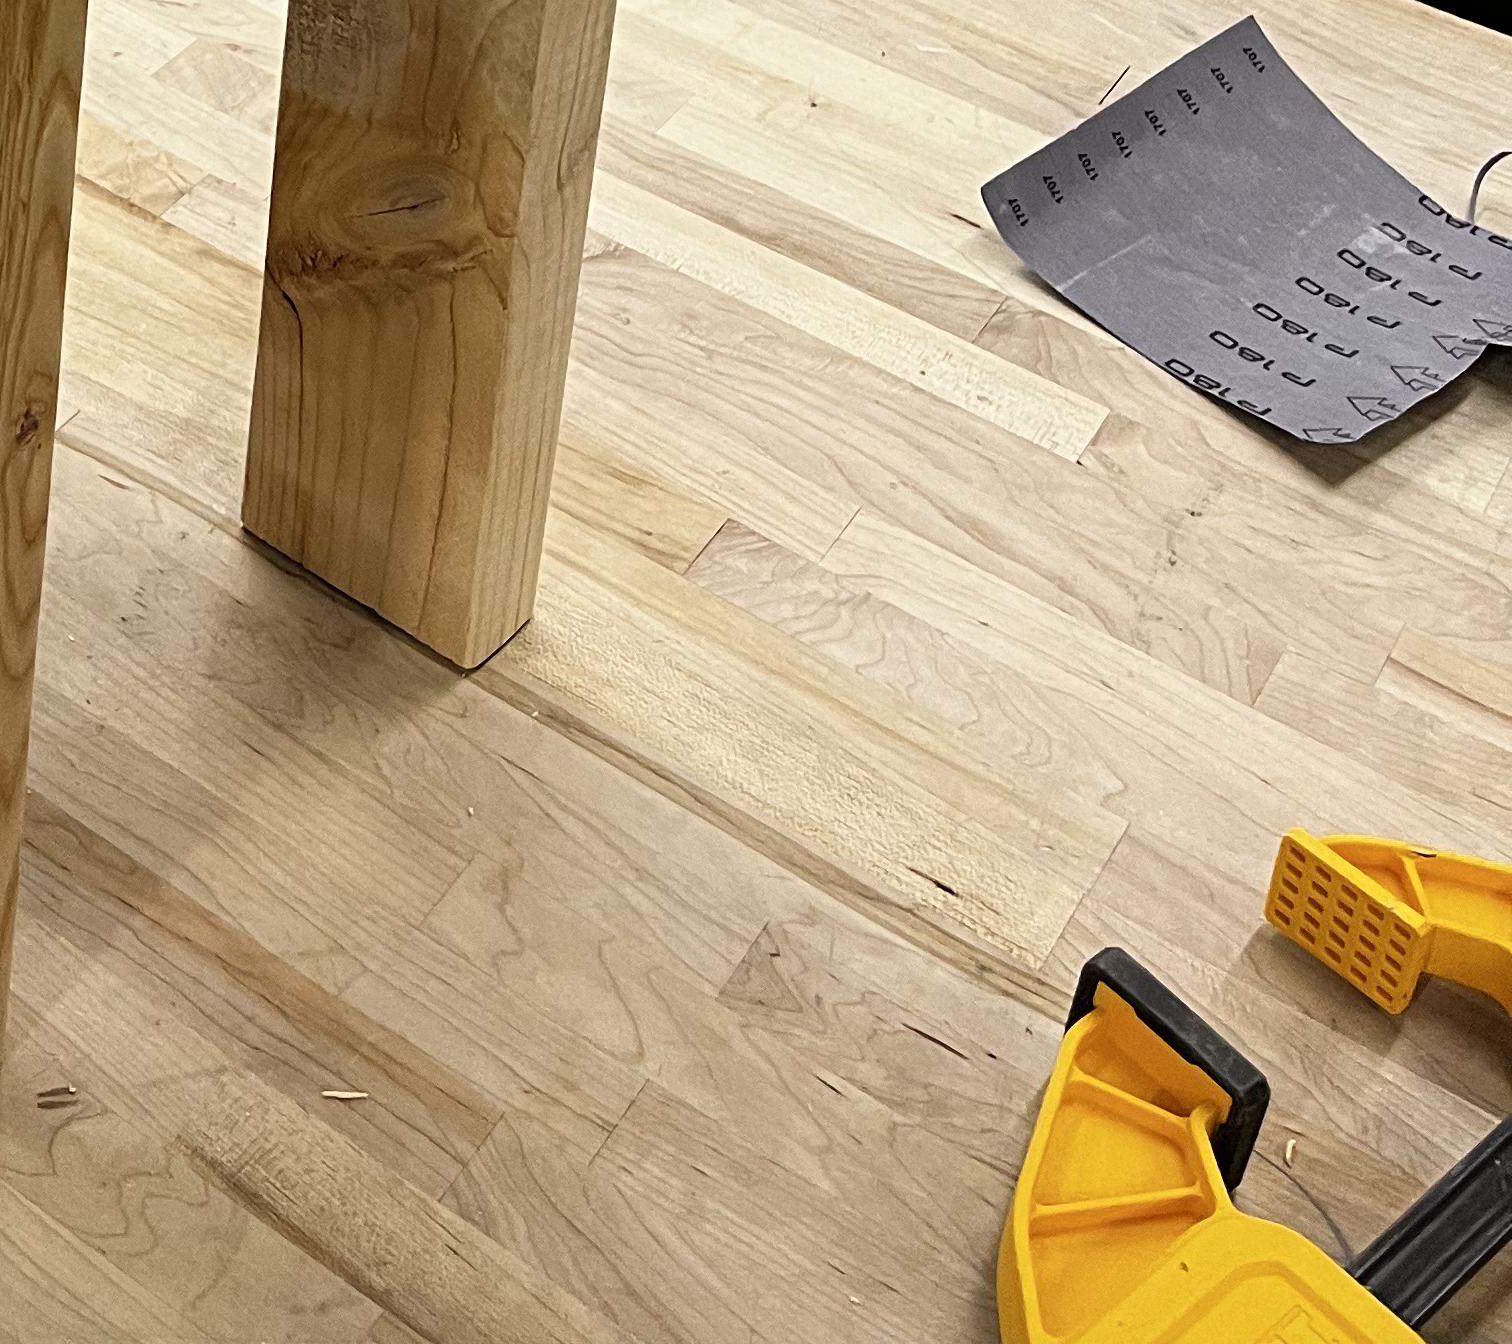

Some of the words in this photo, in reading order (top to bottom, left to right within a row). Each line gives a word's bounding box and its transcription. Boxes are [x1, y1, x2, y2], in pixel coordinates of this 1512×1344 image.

[1242, 47, 1266, 74] 1707
[1210, 67, 1234, 94] 1707
[1176, 88, 1201, 116] 1707
[1144, 109, 1167, 137] 1707
[1111, 131, 1133, 159] 1707
[1077, 153, 1099, 182] 1707
[1042, 175, 1065, 205] 1707
[1007, 198, 1030, 227] 1707
